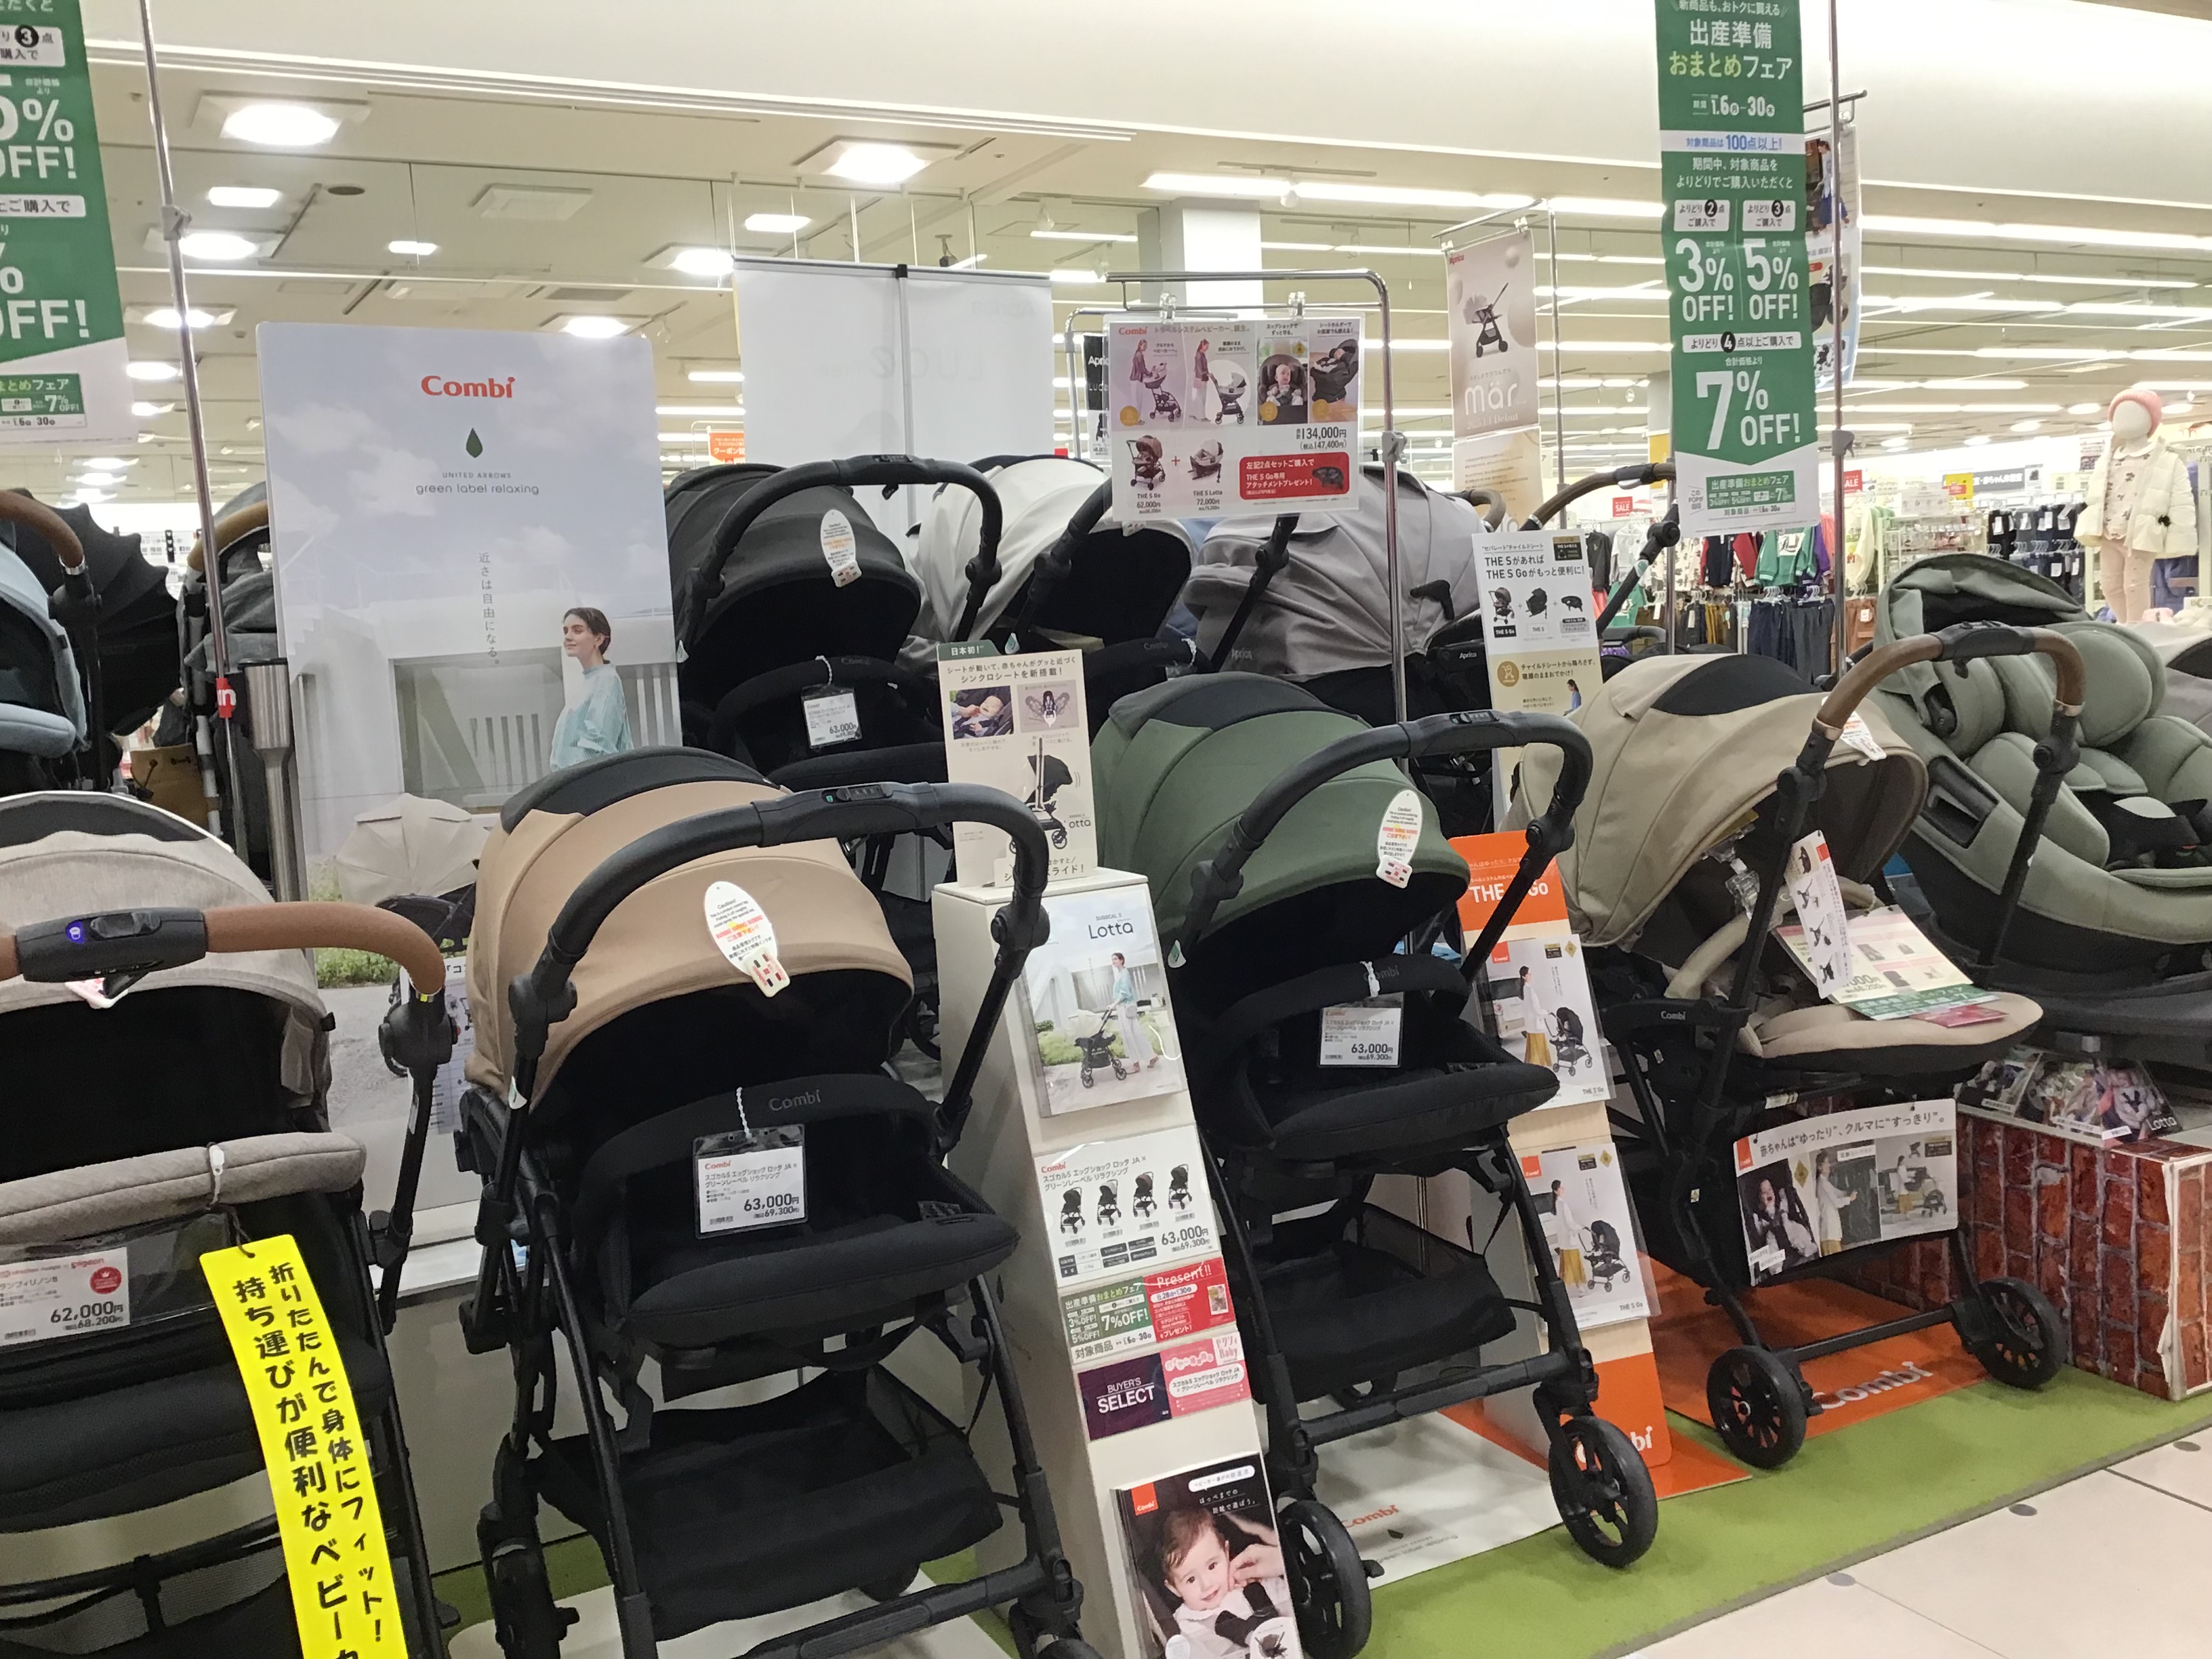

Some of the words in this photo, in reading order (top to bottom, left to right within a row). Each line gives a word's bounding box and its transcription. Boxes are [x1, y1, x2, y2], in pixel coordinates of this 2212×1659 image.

[1689, 19, 1771, 49] 出産準備
[1669, 51, 1793, 80] おまとめフェア
[1692, 157, 1778, 172] 期間中、対象商品を
[1676, 176, 1793, 190] よりどりでご購入いただくと
[1687, 218, 1716, 228] ご購入で
[1755, 218, 1782, 228] ご購入で
[1675, 238, 1734, 292] 3%
[1743, 238, 1799, 291] 5%
[1682, 295, 1734, 322] OFF!
[1749, 293, 1798, 321] OFF!
[0, 300, 89, 339] FF!
[1118, 326, 1148, 335] Combi
[421, 375, 515, 398] Combi
[1494, 413, 1518, 424] Debut
[1696, 371, 1768, 450] 7%
[1741, 413, 1800, 446] OFF!
[1246, 458, 1315, 470] 左記2点セットご購入で
[415, 484, 452, 495] green
[457, 483, 487, 493] label
[491, 484, 539, 495] relaxing
[1246, 478, 1313, 489] アタッチメントプレゼント!
[1711, 475, 1788, 490] 出産準備おまとめフェア
[1485, 556, 1502, 567] THE
[1486, 569, 1504, 579] THE
[1507, 569, 1513, 578] S
[1515, 566, 1584, 578] Goがもっと便利に!
[478, 552, 499, 665] 近さは自由になる。
[951, 646, 980, 655] 日本初!
[947, 657, 1076, 674] シートが動いて、赤ちゃんがグッと近づく
[961, 668, 1062, 683] シンクロシートを新搭載!
[1469, 883, 1504, 903] THE
[1088, 922, 1133, 939] Lotta
[1661, 1010, 1686, 1021] Combi
[1351, 1044, 1393, 1053] 63,000円
[769, 1090, 821, 1111] Combi
[2146, 1116, 2177, 1132] Lotta
[705, 1160, 731, 1170] Combi
[1041, 1162, 1067, 1173] Combi
[1043, 1171, 1071, 1183] スゴカルS
[1073, 1163, 1110, 1176] エッグショック
[1113, 1159, 1129, 1168] ロッタ
[705, 1172, 730, 1181] スゴカルS
[732, 1166, 766, 1177] エッグショック
[705, 1176, 748, 1188] グリーンレーベル
[750, 1172, 781, 1183] リラクシング
[1045, 1176, 1092, 1191] グリーンレーベル
[1094, 1167, 1128, 1181] リラクシング
[744, 1193, 800, 1212] 63,000円
[1162, 1225, 1209, 1246] 63,000円
[71, 1258, 104, 1269] pigeon
[51, 1301, 123, 1324] 62,000円
[1101, 1308, 1148, 1331] 7%OFF!
[1069, 1315, 1097, 1328] 3%OFF!
[1071, 1330, 1100, 1344] 5%OFF!
[1075, 1340, 1113, 1358] 対象商品
[1107, 1377, 1141, 1393] BUYER'S
[1098, 1385, 1155, 1414] SELECT
[269, 1262, 384, 1642] 折りたたんで身体にフィット!
[1137, 1500, 1155, 1512] Combi
